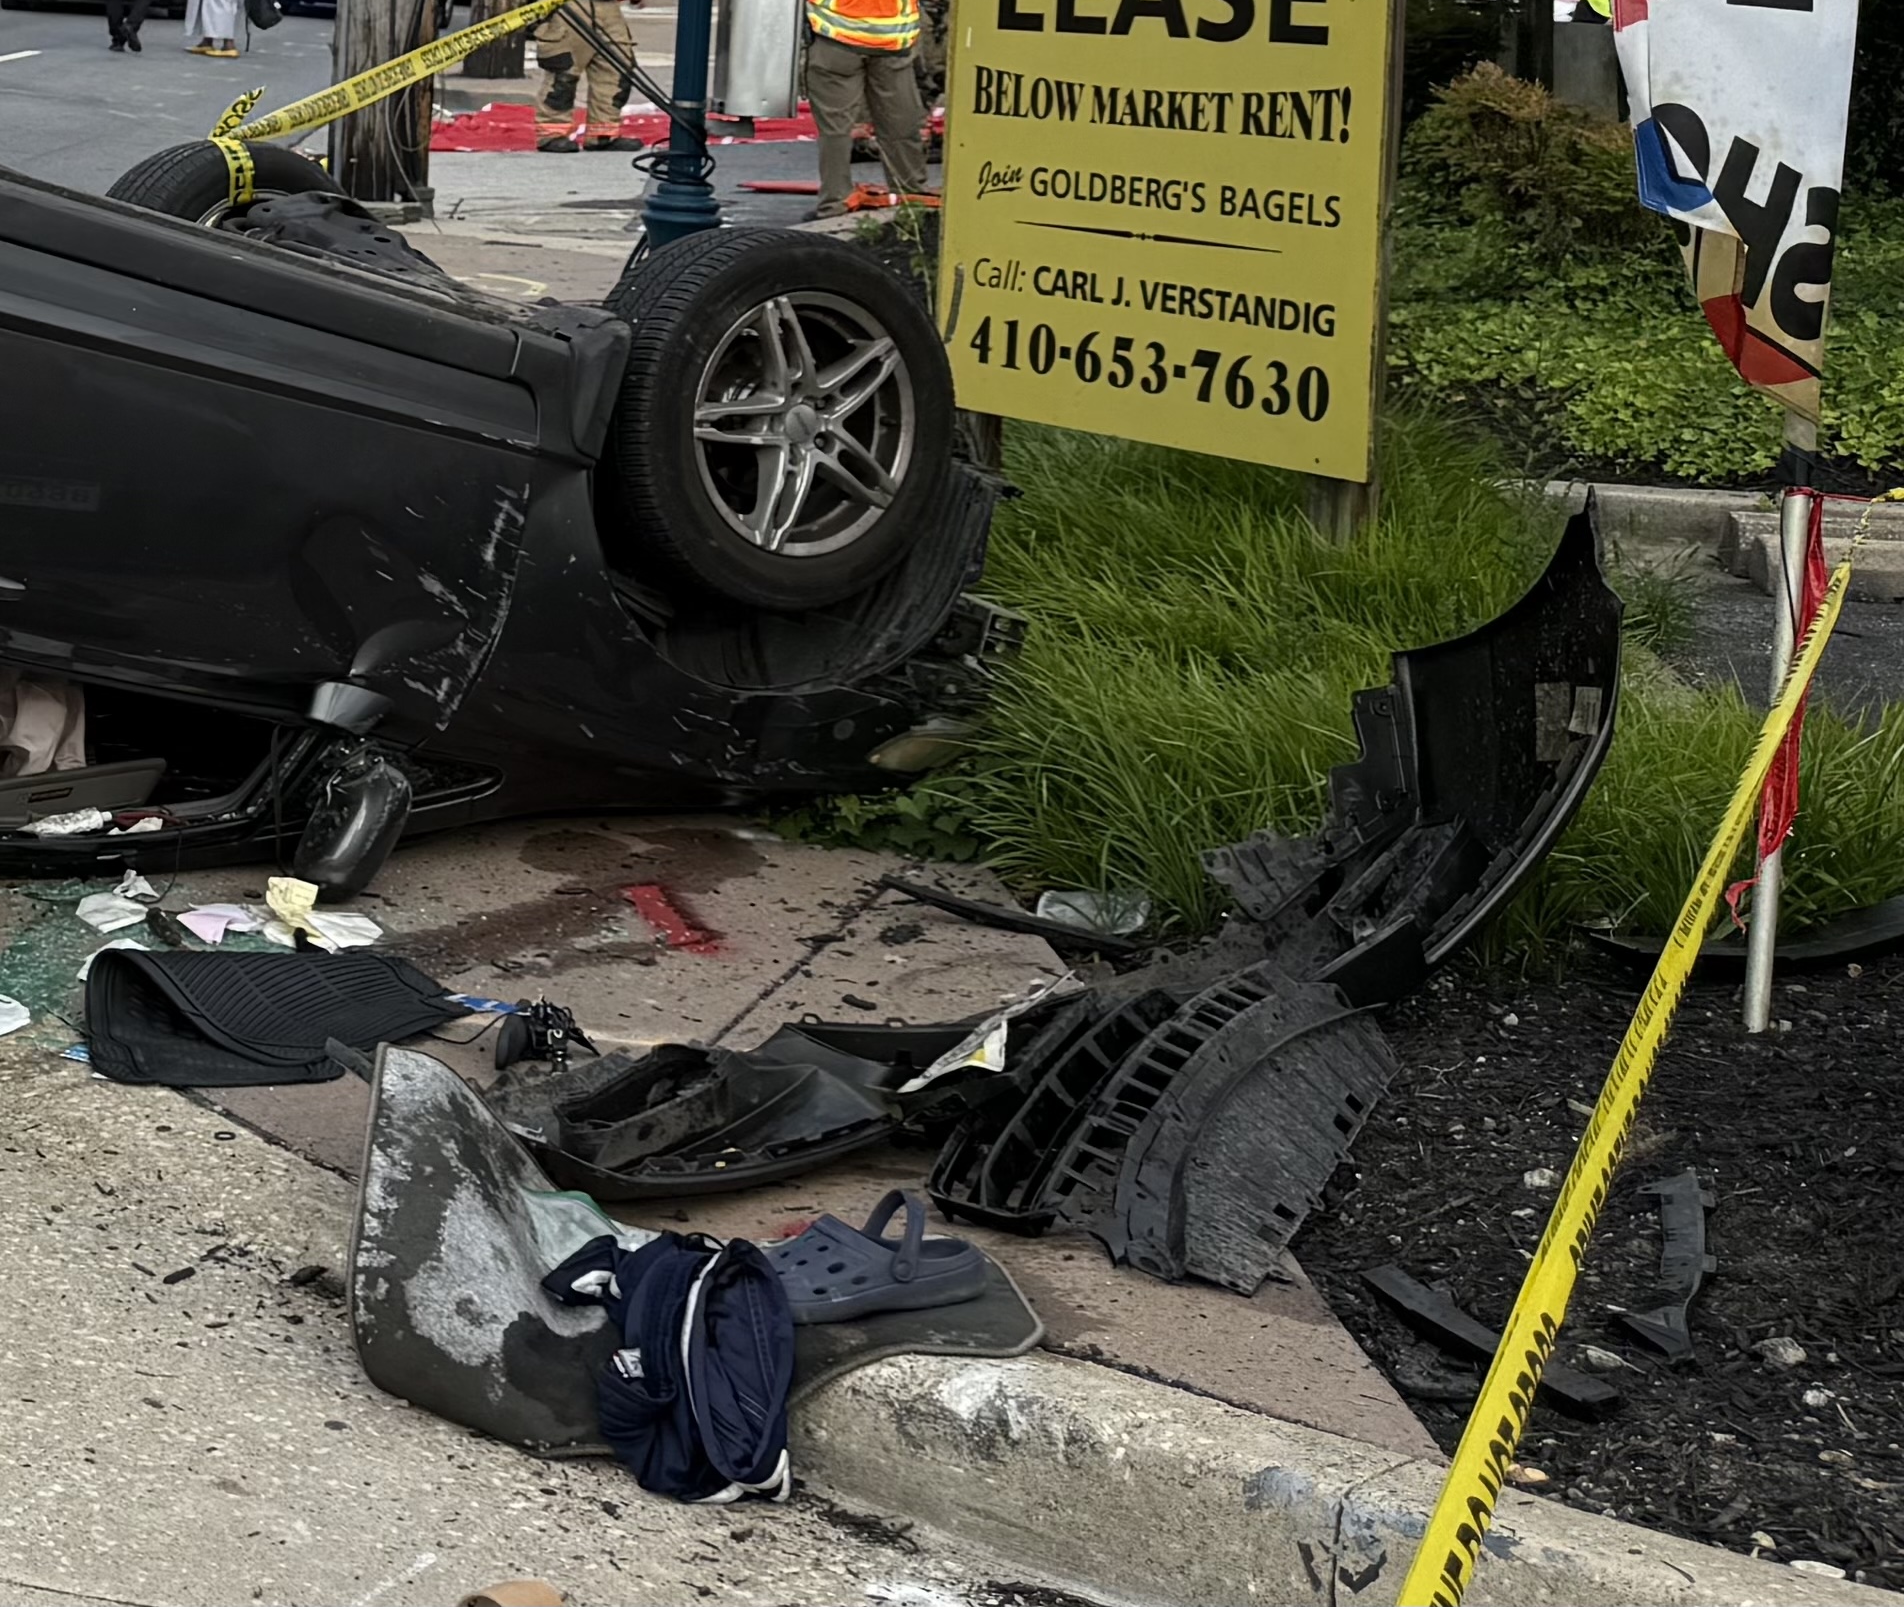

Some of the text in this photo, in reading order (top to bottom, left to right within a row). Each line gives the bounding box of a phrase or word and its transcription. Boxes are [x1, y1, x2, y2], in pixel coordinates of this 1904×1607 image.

[972, 65, 1352, 145] BELOW MARKET RENT!
[976, 161, 1342, 229] Join GOLDBERG'S BAGELS
[972, 257, 1337, 338] Call: CARL J. VERSTANDIG
